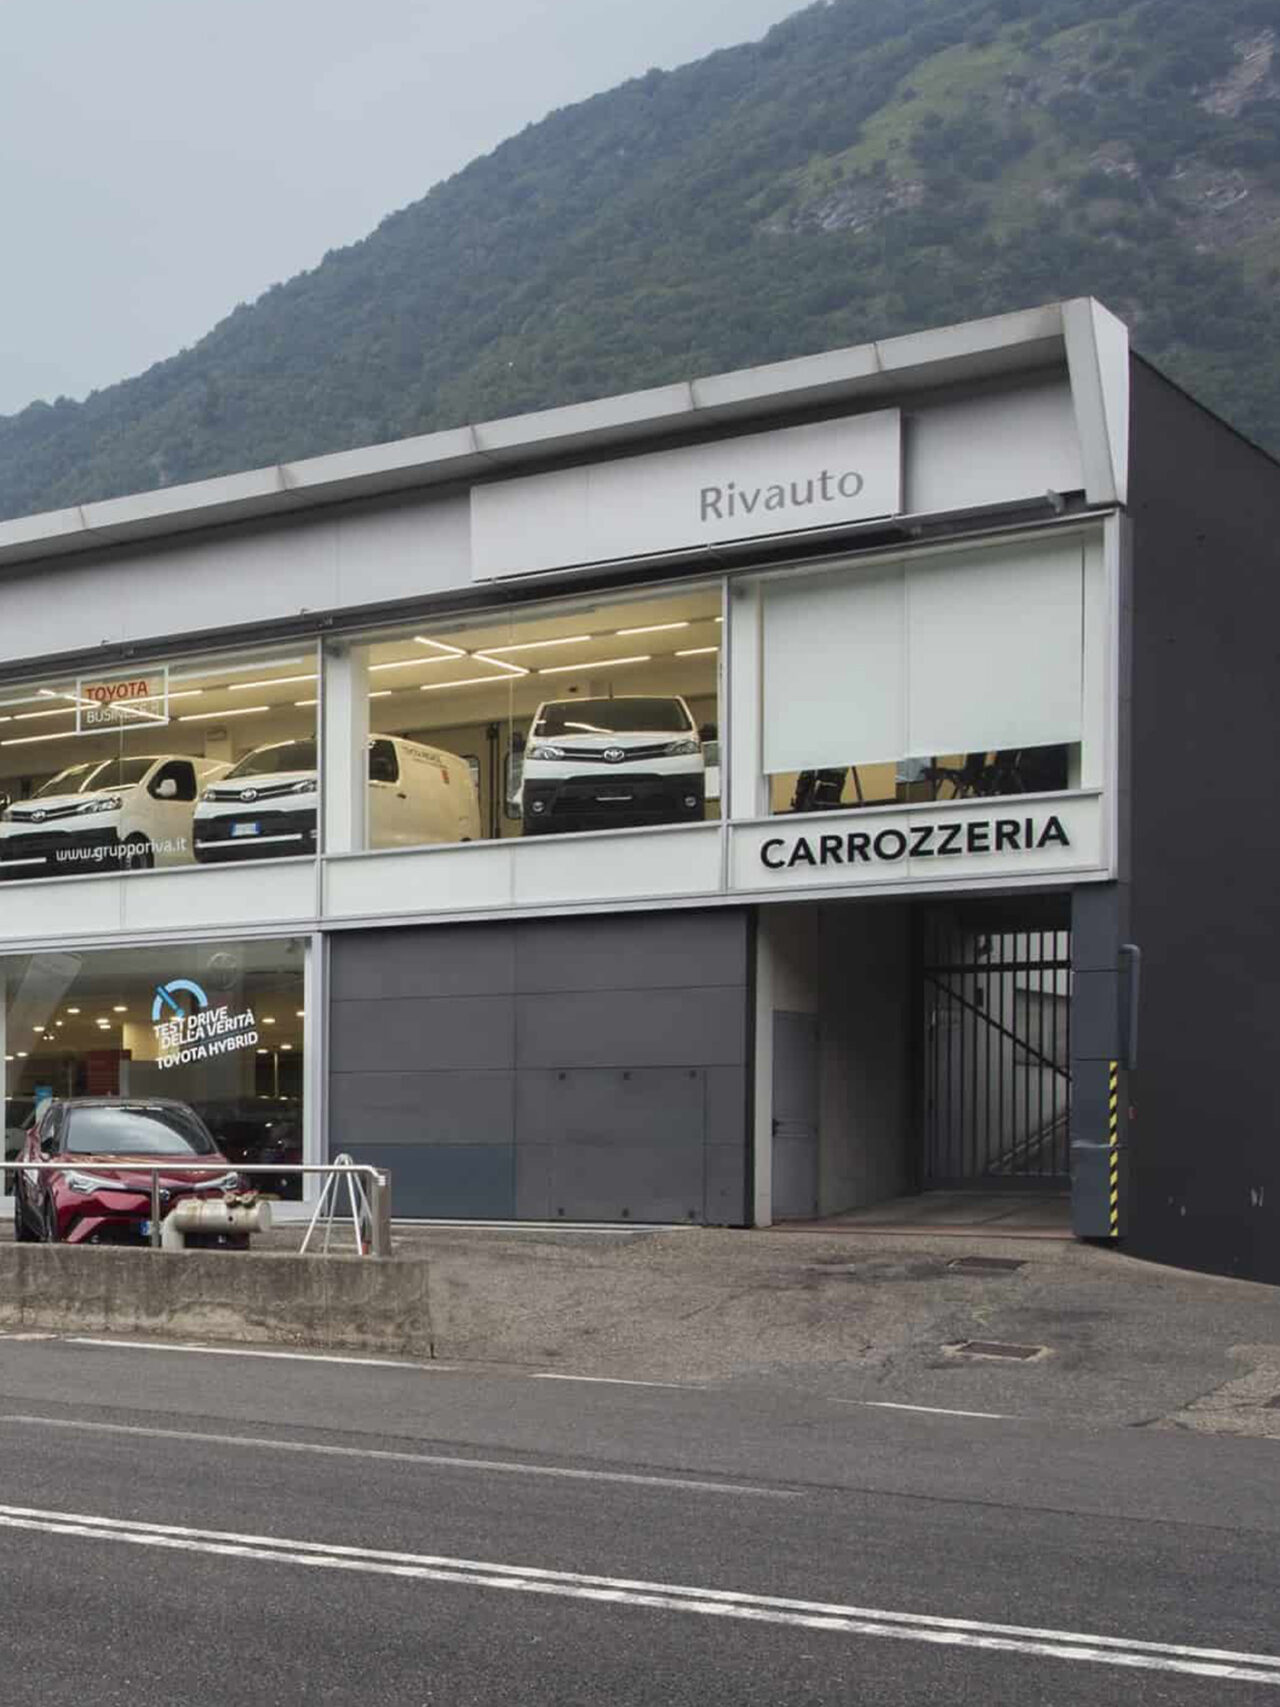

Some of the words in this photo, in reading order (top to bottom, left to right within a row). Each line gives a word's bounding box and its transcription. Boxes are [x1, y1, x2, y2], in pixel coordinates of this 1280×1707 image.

[699, 468, 864, 522] Rivauto
[85, 681, 148, 701] TOYOTA
[56, 837, 187, 862] www.grupporiva.it
[760, 815, 1070, 869] CARROZZERIA
[153, 1018, 184, 1039] TEST
[188, 1006, 227, 1030] DRIVE
[161, 1027, 205, 1049] DELLA
[207, 1009, 255, 1036] VERITÀ
[156, 1046, 208, 1070] TOYOTA
[208, 1032, 259, 1056] HYBRID
